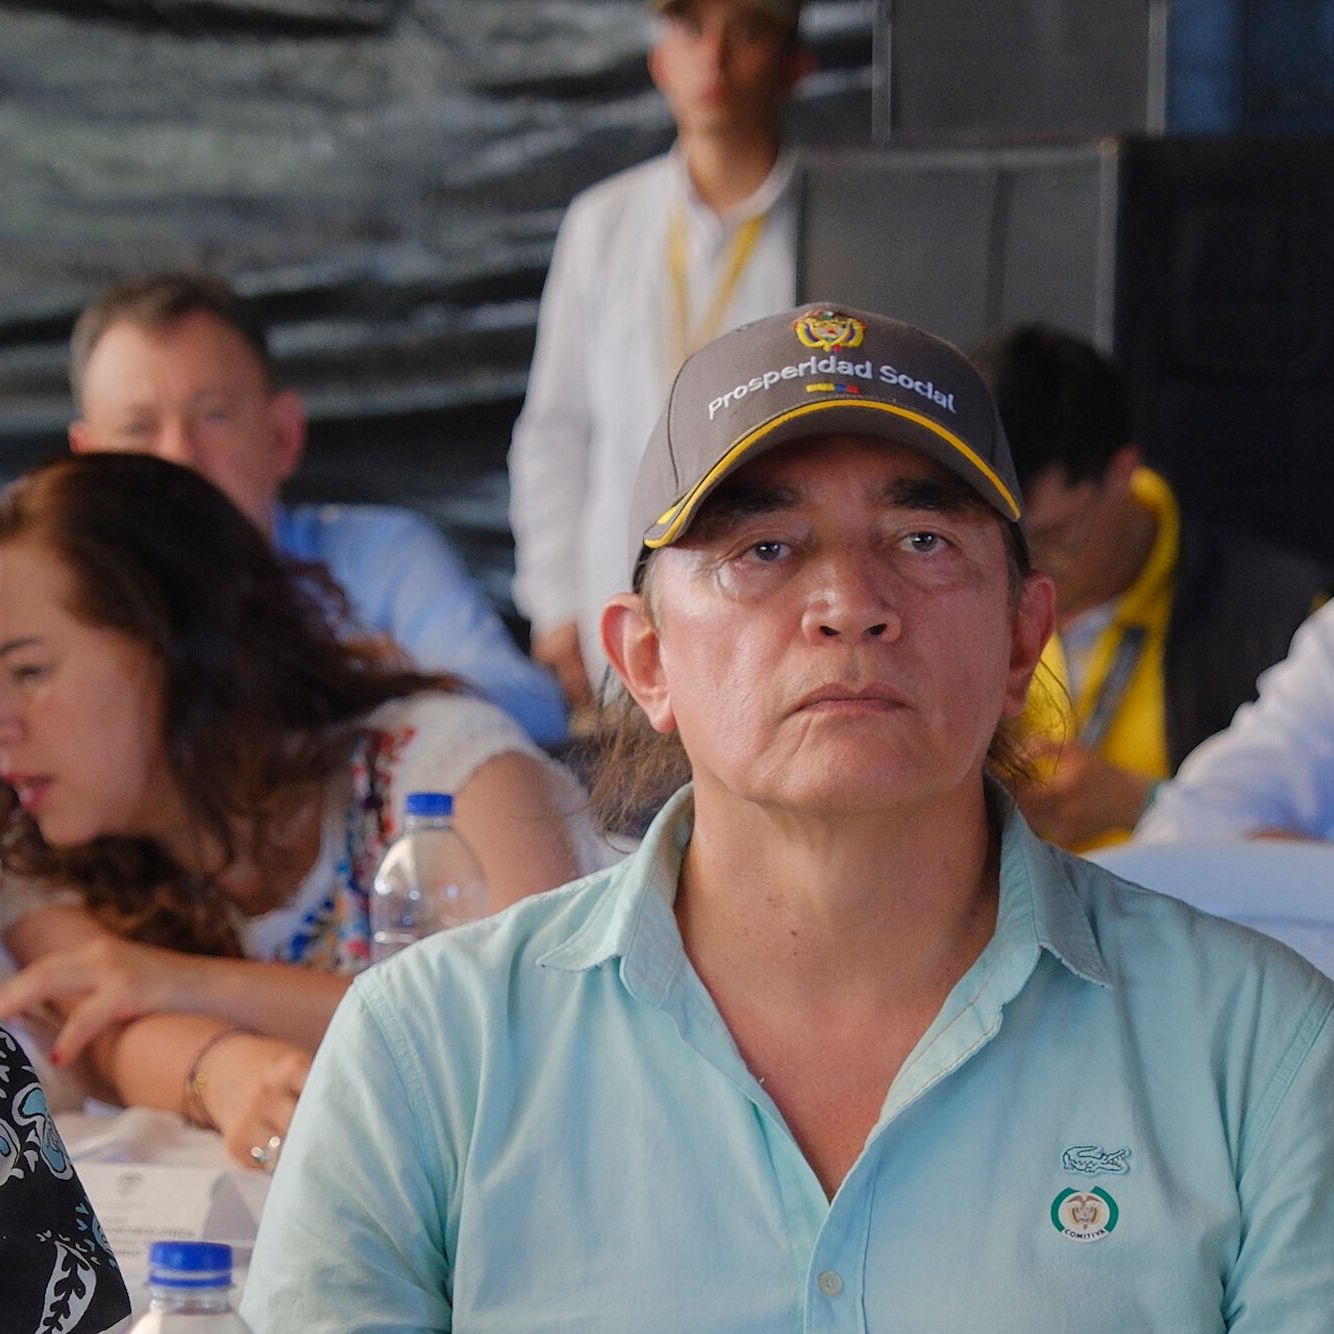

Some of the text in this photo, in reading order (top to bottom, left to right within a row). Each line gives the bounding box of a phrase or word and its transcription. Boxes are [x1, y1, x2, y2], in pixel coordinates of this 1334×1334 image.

[707, 355, 957, 420] Prosperidad Social
[1065, 1229, 1105, 1239] COMITIVA
